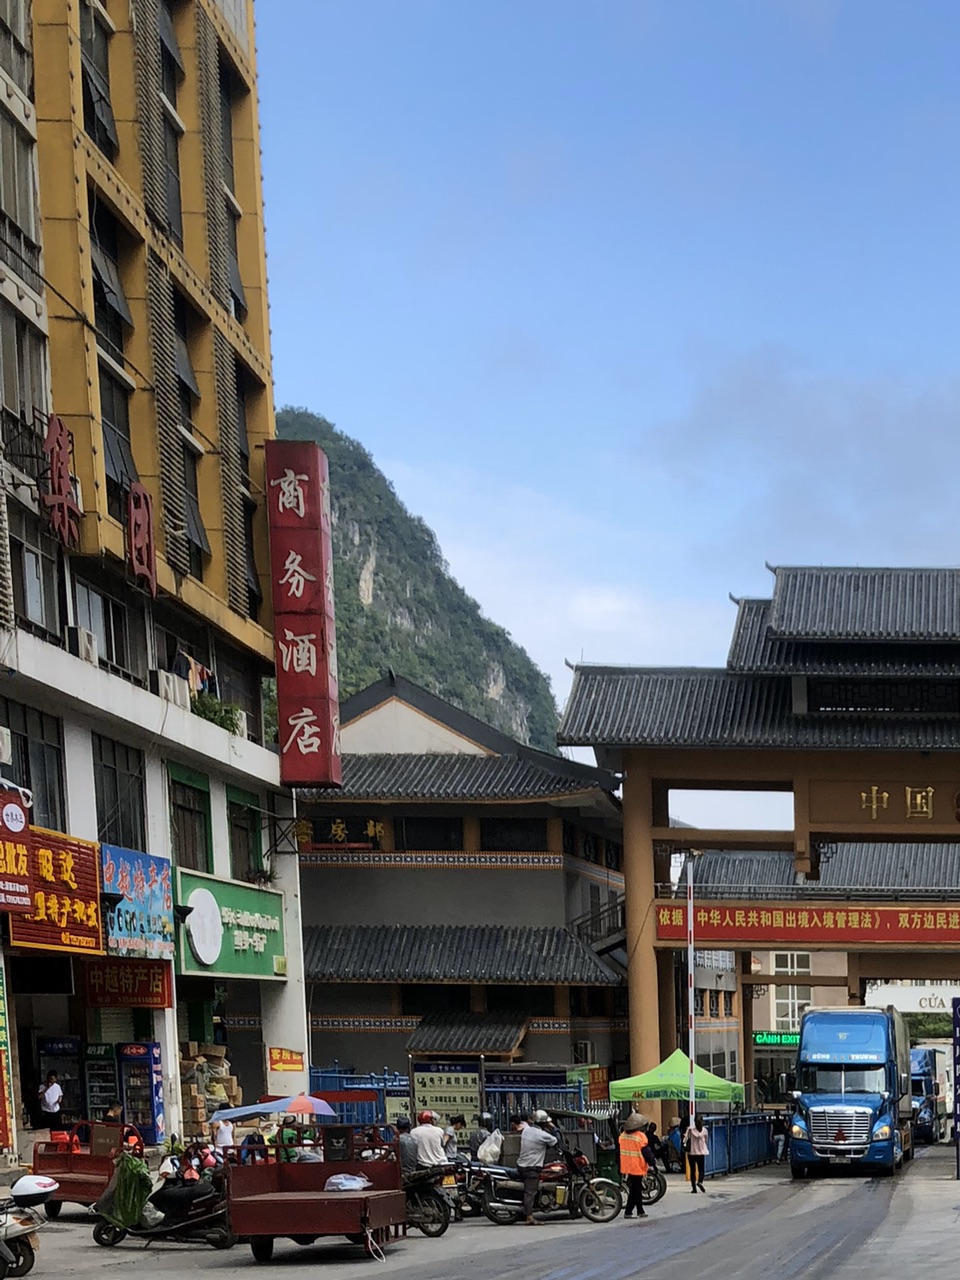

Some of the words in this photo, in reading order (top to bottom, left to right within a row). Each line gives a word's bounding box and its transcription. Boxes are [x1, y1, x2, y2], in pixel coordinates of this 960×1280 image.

[269, 467, 323, 756] 商务酒店
[860, 785, 936, 820] 中国
[89, 965, 162, 993] 中越特产店
[919, 993, 945, 1009] CỬA
